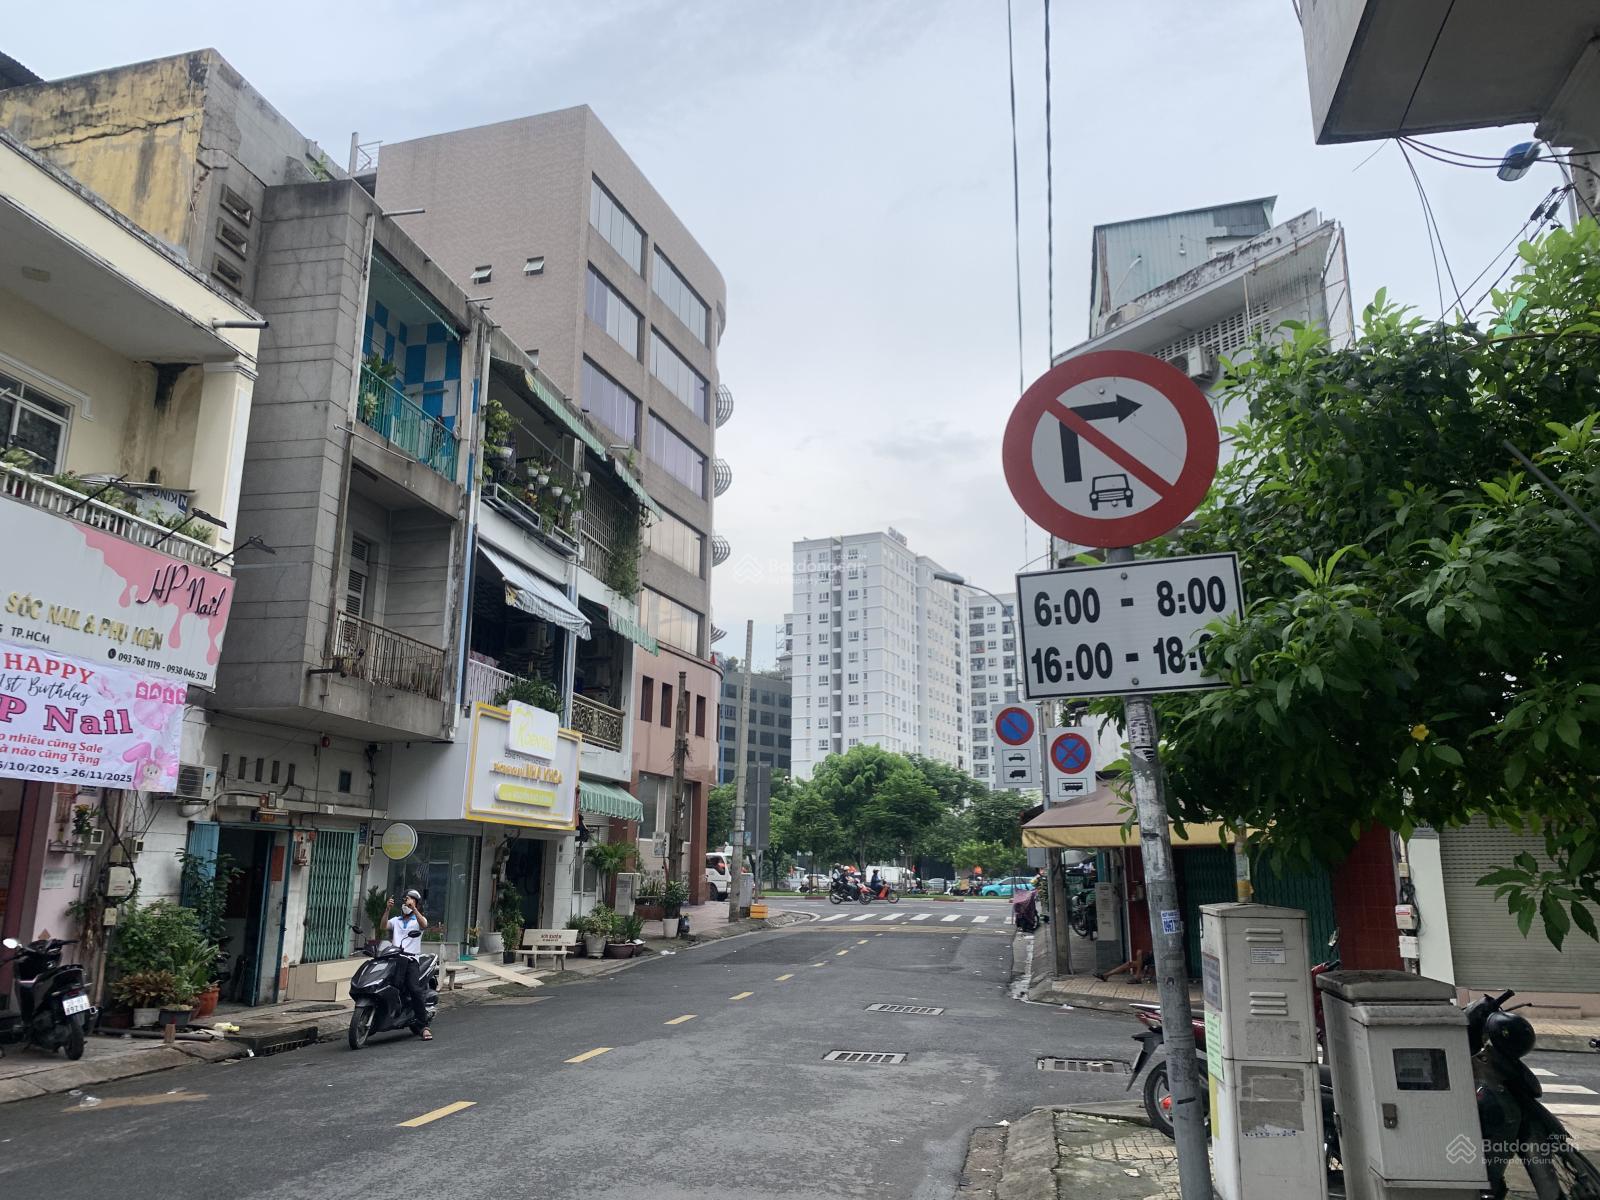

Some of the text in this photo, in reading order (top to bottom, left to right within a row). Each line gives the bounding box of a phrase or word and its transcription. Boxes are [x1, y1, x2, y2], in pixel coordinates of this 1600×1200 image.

[136, 564, 227, 616] HP Nail
[1034, 576, 1226, 627] 6:00 - 8:00
[5, 592, 164, 651] SÓC NAIL & PHỤ KIỆN
[11, 626, 50, 644] TP.HCM
[4, 652, 95, 685] HAPPY
[118, 652, 132, 664] 093
[133, 656, 146, 667] 768
[147, 660, 161, 670] 1119
[166, 664, 183, 675] 0938
[184, 668, 196, 678] 046
[196, 671, 208, 681] 528
[1031, 632, 1216, 684] 16:00 - 18:0
[0, 673, 92, 706] 1st Birthday
[43, 704, 133, 735] Nail
[8, 734, 45, 746] nhiêu
[47, 738, 77, 752] cũng
[79, 742, 103, 753] Sale
[11, 746, 36, 757] nào
[38, 750, 68, 762] cũng
[71, 752, 101, 766] Tặng
[71, 768, 133, 783] 26/11/2025
